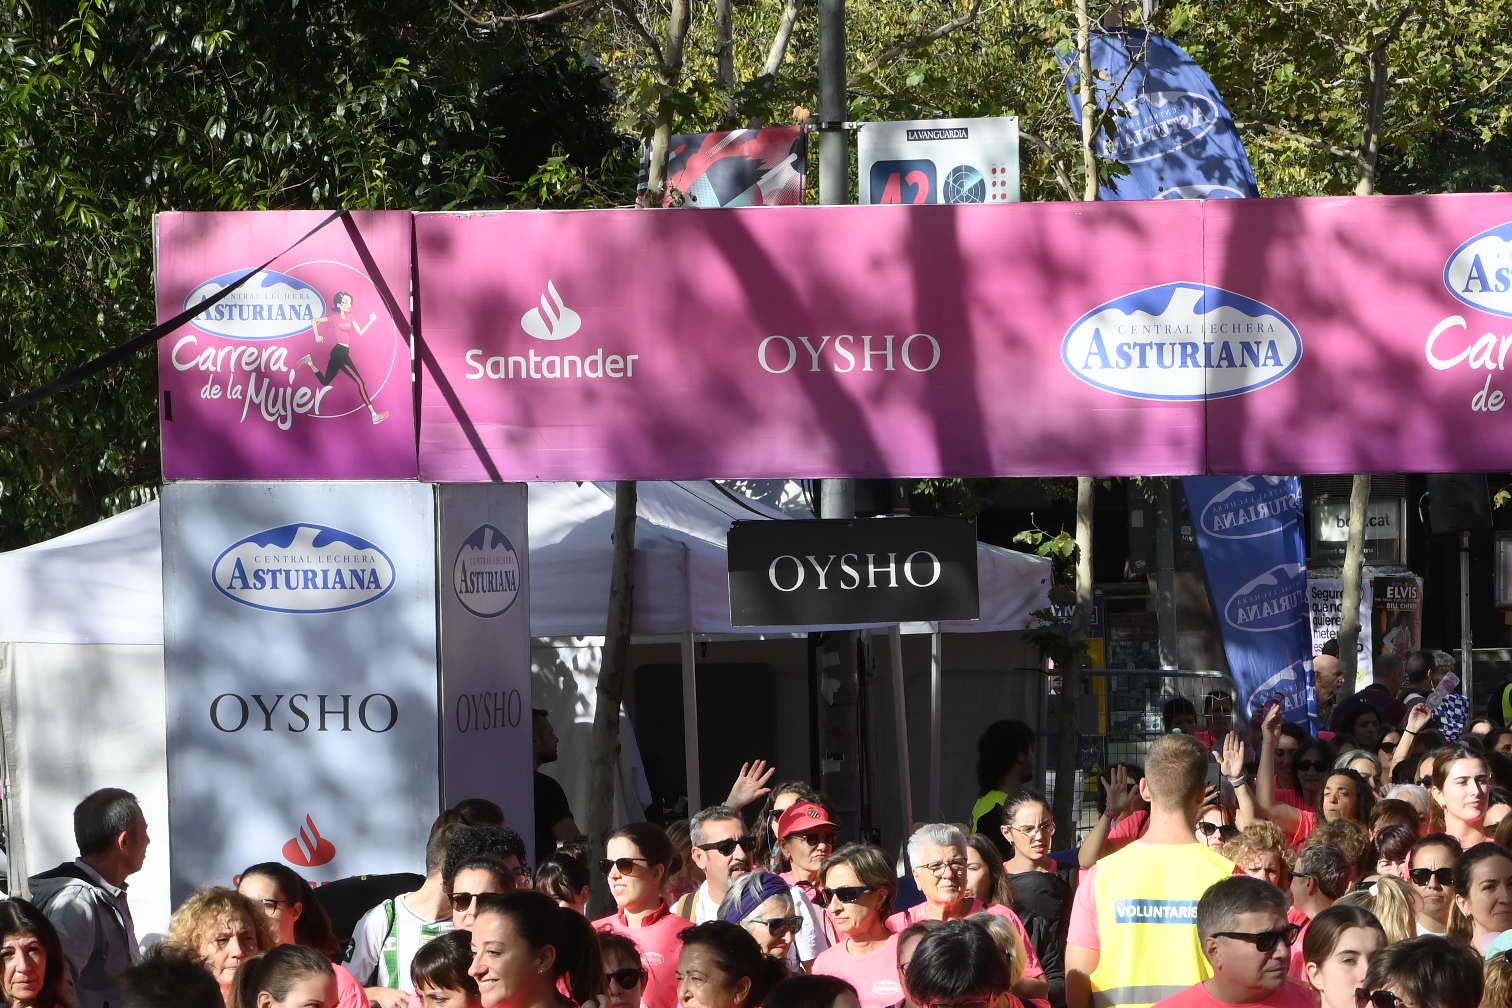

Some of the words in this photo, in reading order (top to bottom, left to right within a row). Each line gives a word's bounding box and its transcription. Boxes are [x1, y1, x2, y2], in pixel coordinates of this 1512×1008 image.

[919, 129, 967, 140] VANGUARDIA
[171, 335, 288, 372] Carrera
[465, 347, 639, 380] Santander
[757, 333, 942, 374] OYSHO
[1081, 327, 1284, 370] ASTURIANA
[200, 373, 224, 400] de
[226, 370, 242, 400] la
[241, 368, 333, 430] Mujer
[1472, 379, 1504, 412] de
[227, 556, 382, 591] ASTURIANA
[254, 555, 313, 564] CENTRAL
[318, 554, 376, 564] LECHERA
[459, 559, 516, 594] ASTURIANA
[768, 550, 941, 592] OYSHO
[1386, 586, 1417, 598] ELVIS
[1313, 615, 1344, 627] quiere
[209, 693, 399, 733] OYSHO
[456, 689, 522, 733] OYSHO
